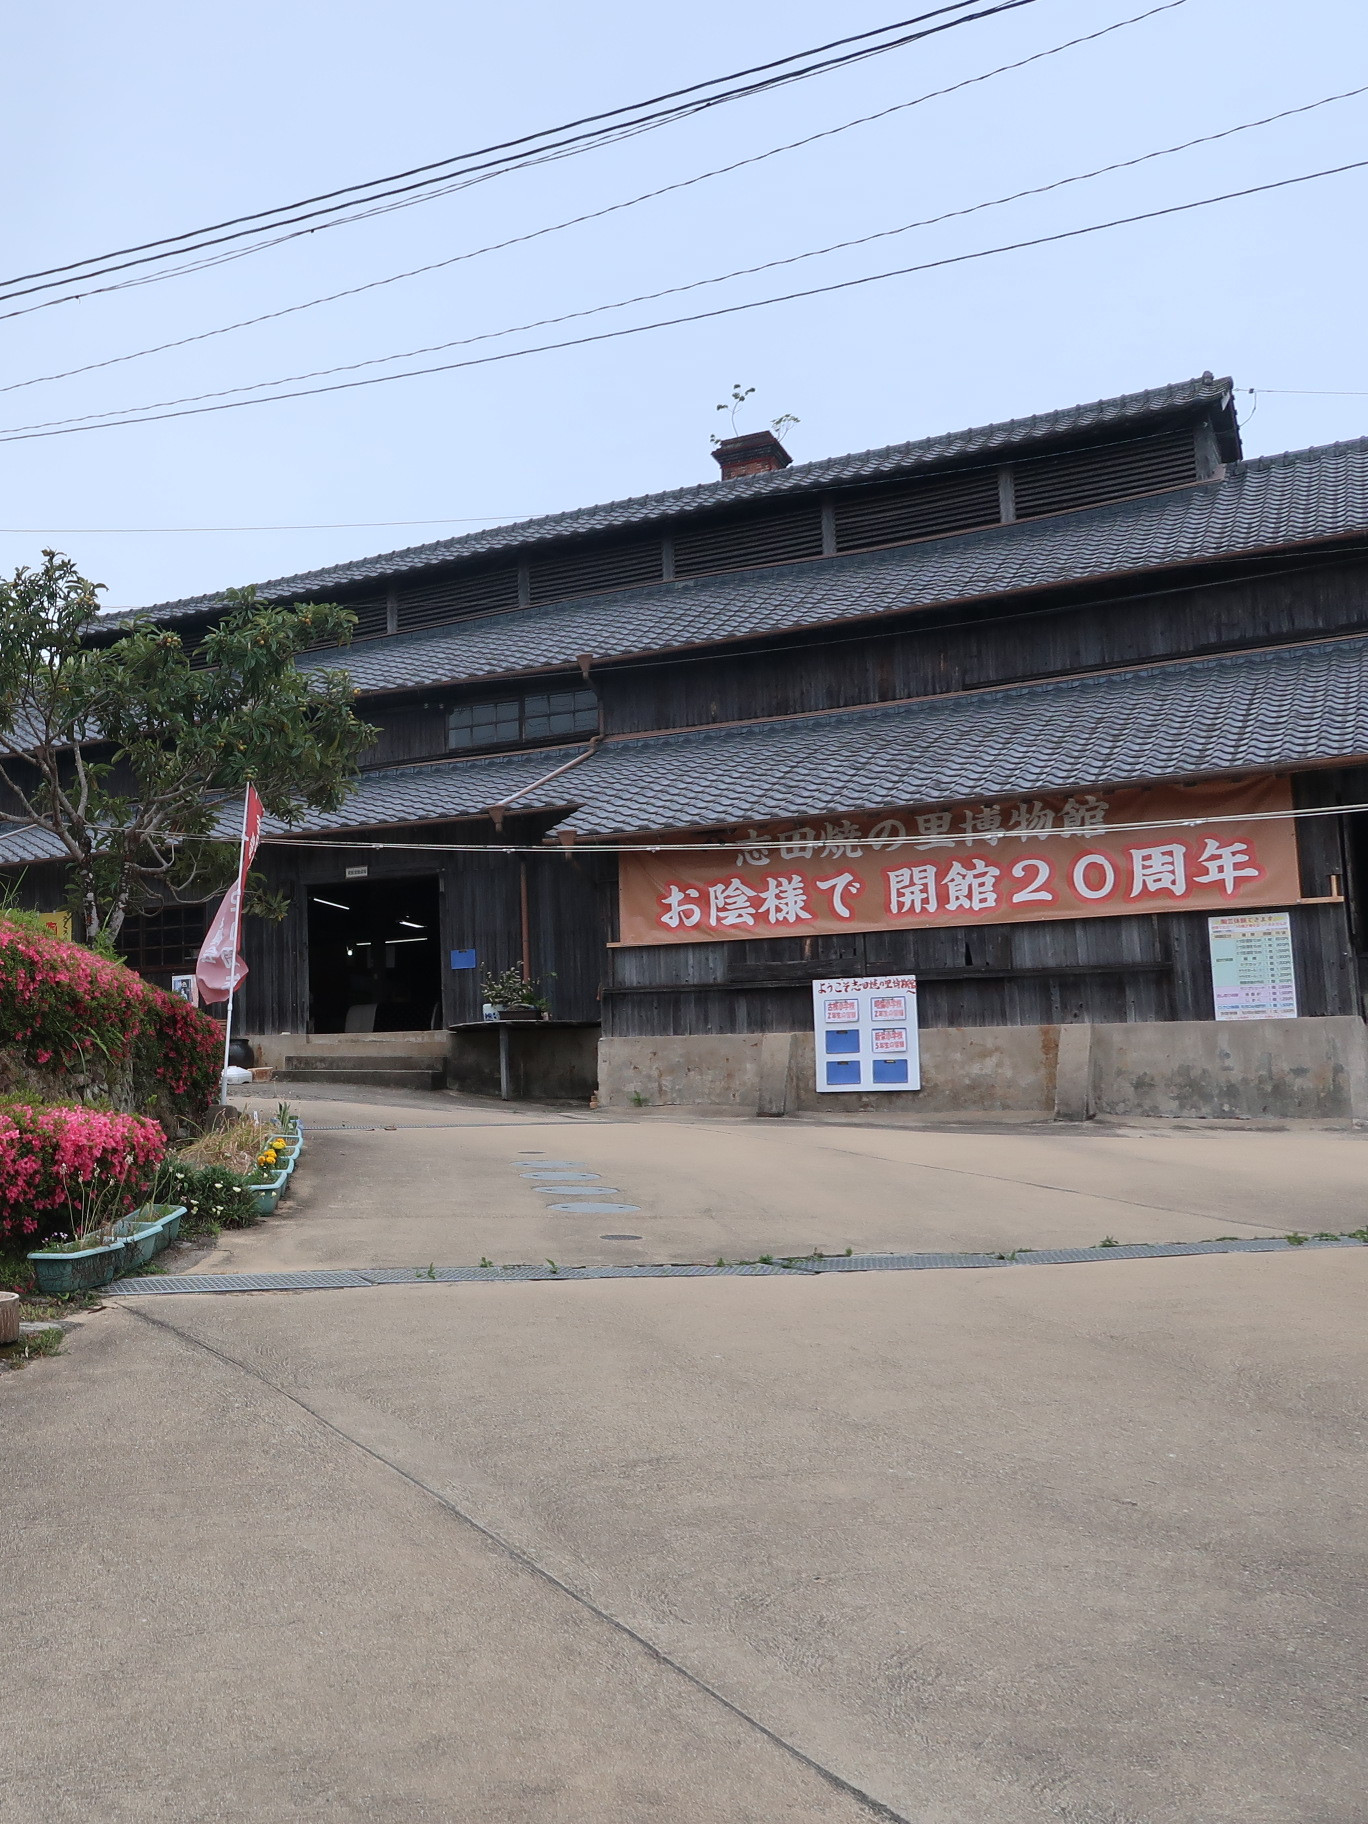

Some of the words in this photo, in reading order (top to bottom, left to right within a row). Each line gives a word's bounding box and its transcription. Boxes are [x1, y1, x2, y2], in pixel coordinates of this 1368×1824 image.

[736, 795, 1110, 866] 志田焼の里博物館
[660, 872, 861, 928] お陰様で
[887, 838, 1259, 914] 開館20周年
